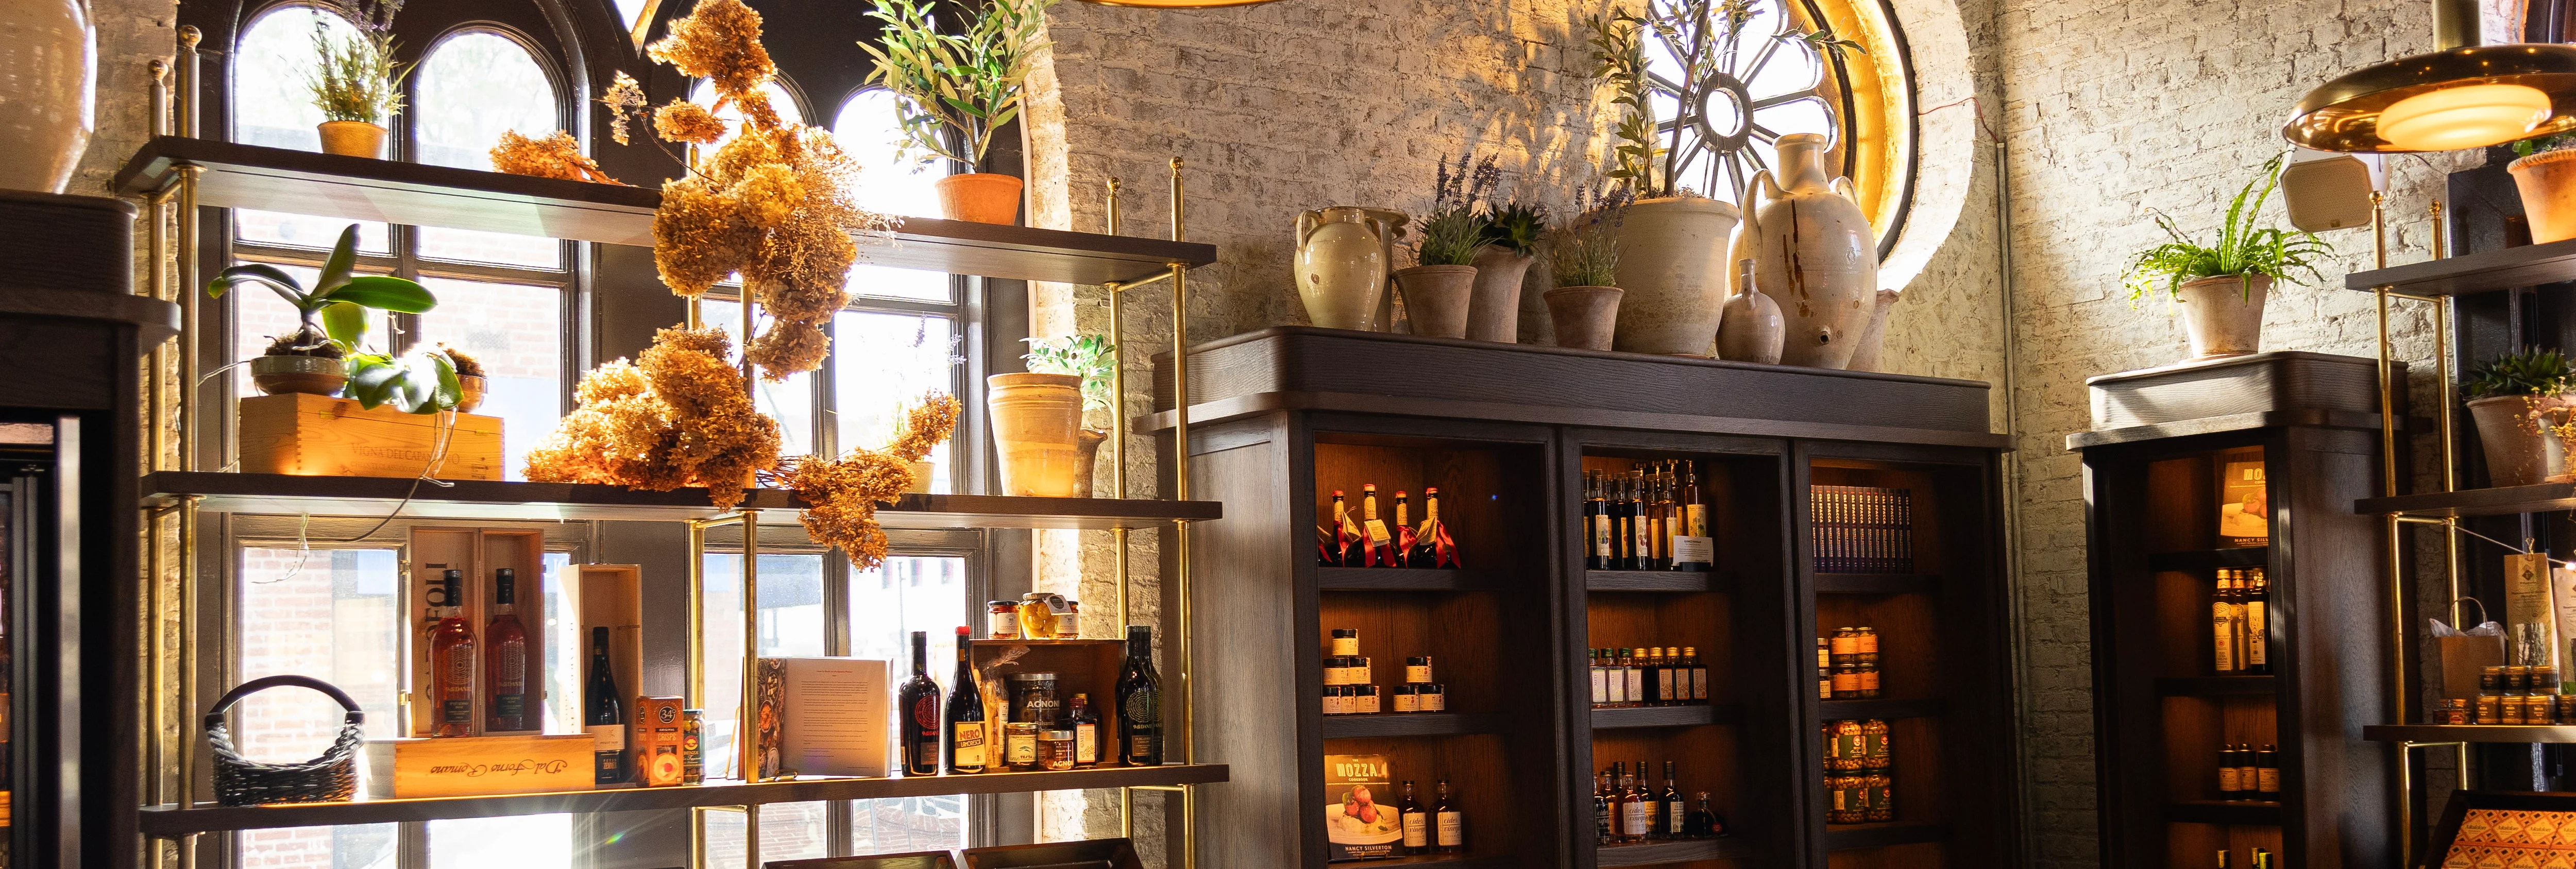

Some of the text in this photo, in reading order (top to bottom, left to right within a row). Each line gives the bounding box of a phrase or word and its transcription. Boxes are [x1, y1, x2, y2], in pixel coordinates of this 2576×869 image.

[2243, 468, 2265, 481] MO
[658, 733, 676, 742] CRISPS
[959, 729, 980, 741] NERO
[430, 762, 487, 777] Romano
[1335, 763, 1378, 777] MOZZA
